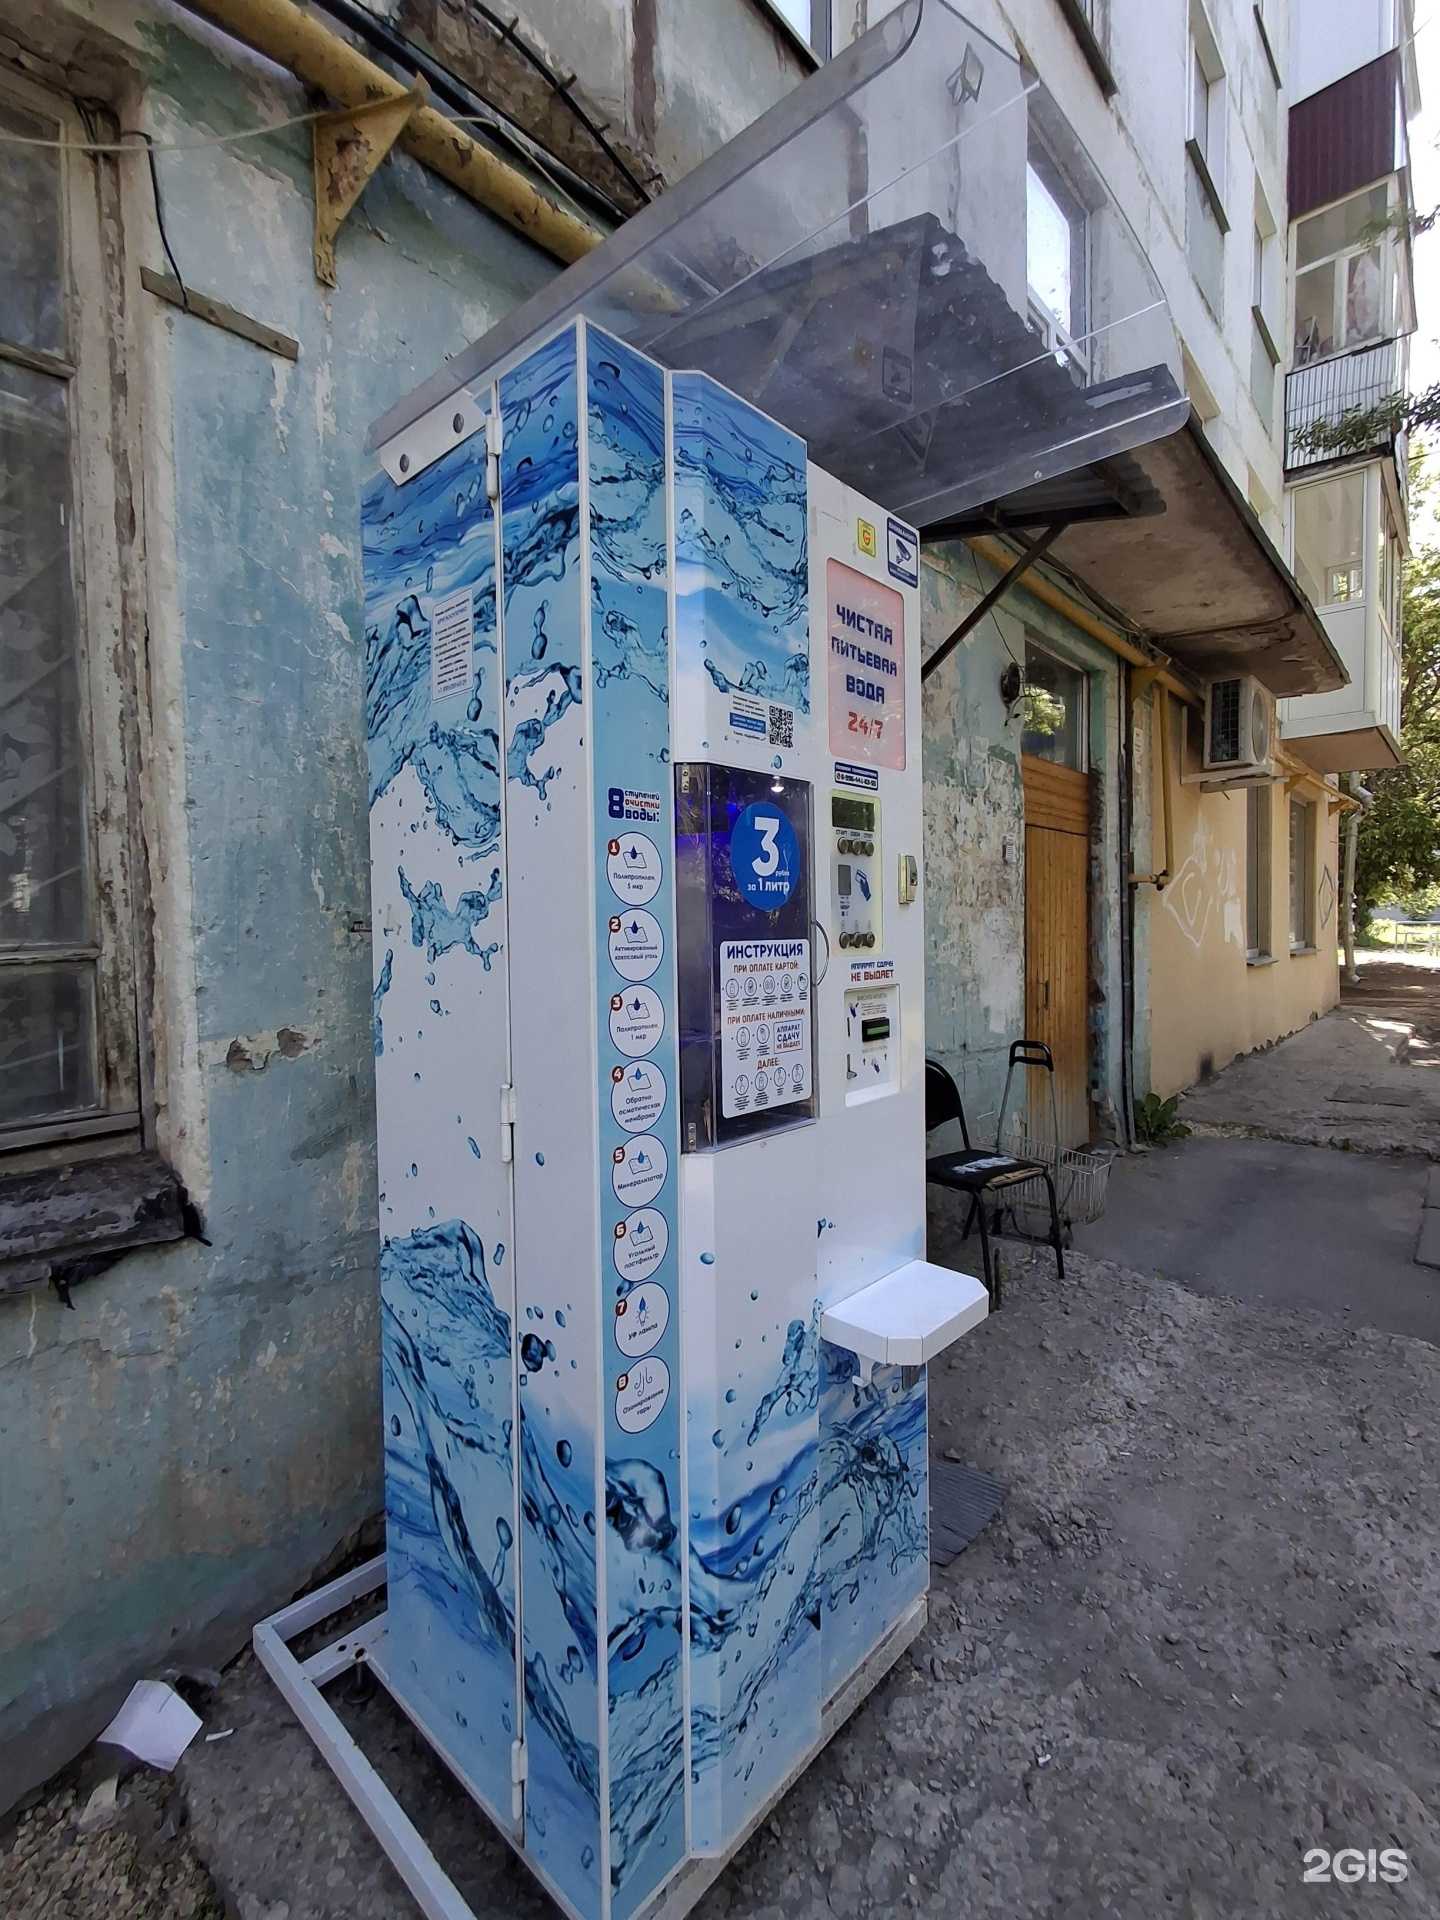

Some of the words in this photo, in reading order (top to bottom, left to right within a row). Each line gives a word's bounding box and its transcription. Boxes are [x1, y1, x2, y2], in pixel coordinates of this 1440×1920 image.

[836, 604, 893, 645] ЧИСТАЯ
[831, 636, 897, 676] ПИТЬЕВАЯ
[846, 675, 884, 704] ВОДА
[848, 712, 883, 739] 24/7
[625, 790, 660, 800] ступеней
[608, 788, 624, 819] 8
[625, 799, 660, 809] очистки
[625, 809, 660, 822] воды:
[752, 816, 780, 877] 3
[758, 878, 763, 892] 1
[765, 881, 790, 895] литр
[610, 918, 619, 931] 2
[727, 943, 804, 959] ИНСТРУКЦИЯ
[734, 964, 747, 973] ПРИ
[749, 962, 773, 972] ОПЛАТЕ
[775, 960, 798, 970] КАРТОЙ
[851, 972, 862, 982] НЕ
[864, 969, 894, 981] ВЫДАЕТ
[727, 1015, 741, 1024] ПРИ
[742, 1012, 765, 1023] ОПЛАТЕ
[757, 1058, 779, 1070] ДАЛЕЕ
